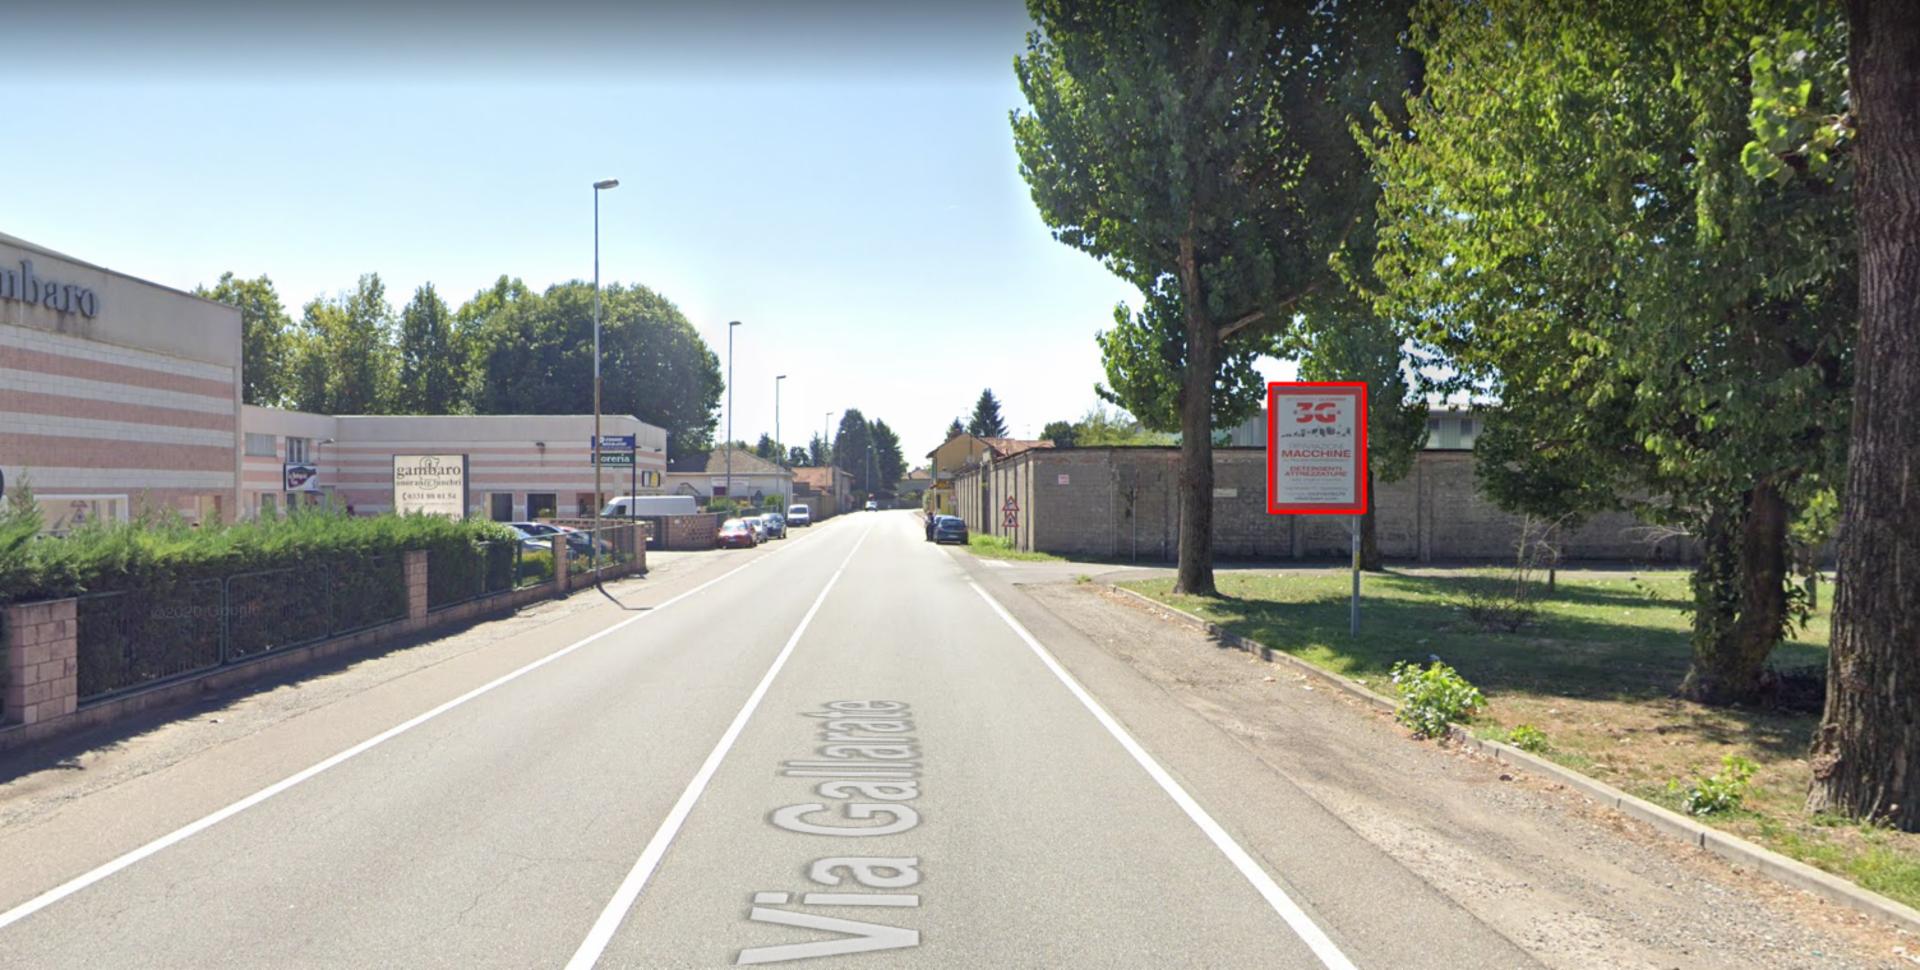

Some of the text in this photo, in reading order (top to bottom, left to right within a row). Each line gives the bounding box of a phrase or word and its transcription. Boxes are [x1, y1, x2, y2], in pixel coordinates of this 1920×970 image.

[1296, 402, 1336, 423] 3G
[1281, 449, 1351, 458] MACCHINE
[396, 463, 461, 480] gambaro
